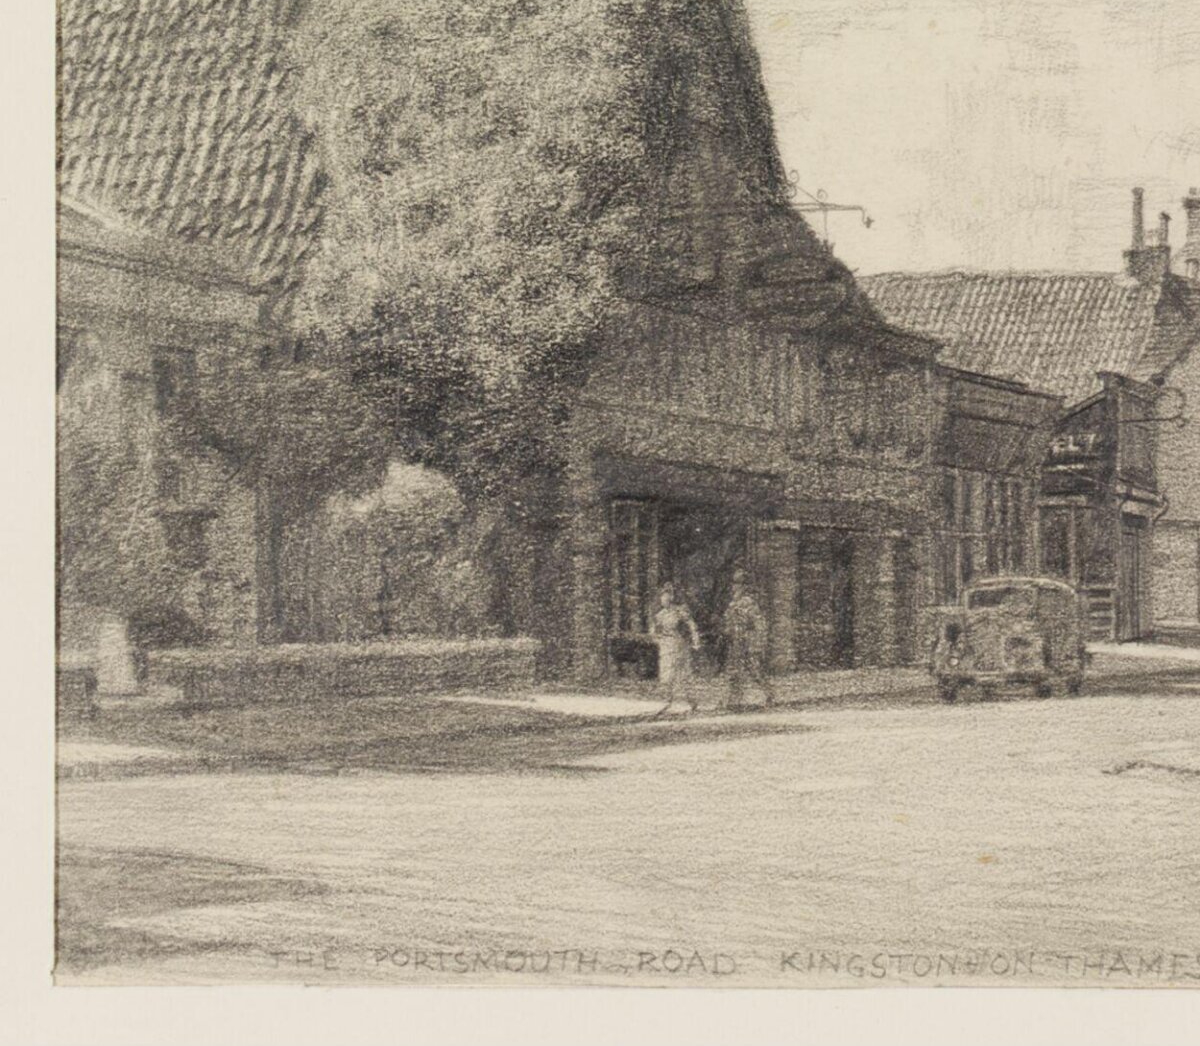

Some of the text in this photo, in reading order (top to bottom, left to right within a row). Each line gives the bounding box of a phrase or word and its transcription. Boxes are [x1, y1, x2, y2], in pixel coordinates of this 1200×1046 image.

[267, 949, 341, 971] THE
[372, 947, 601, 974] PORTSMOUTH
[636, 948, 738, 975] ROAD
